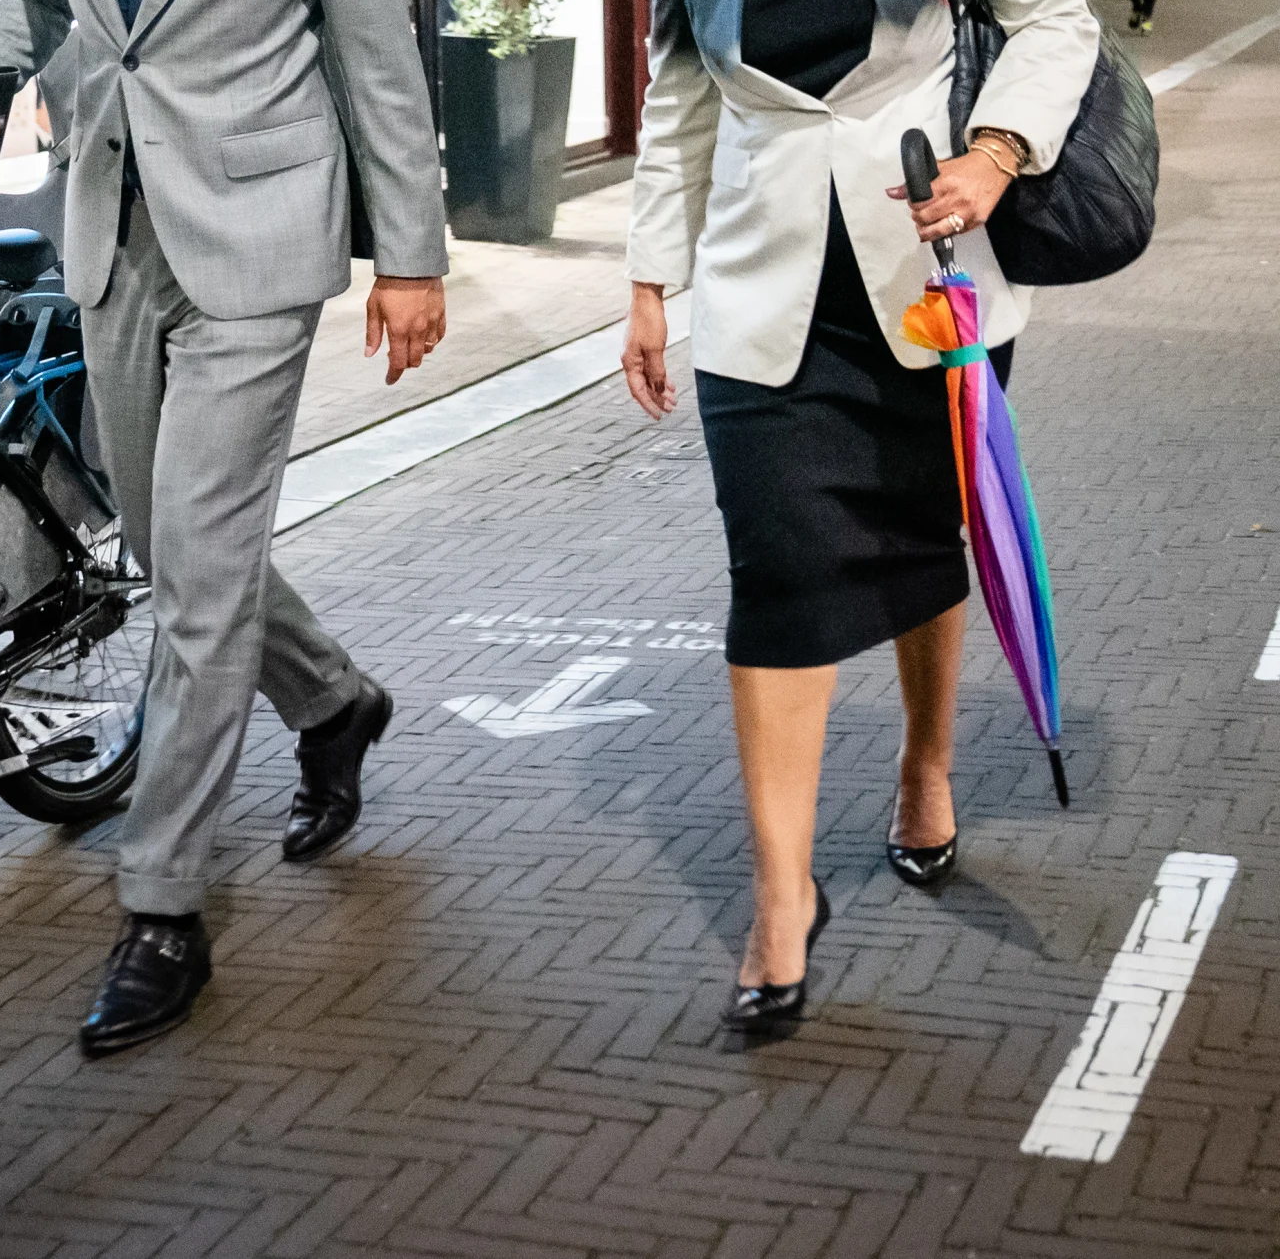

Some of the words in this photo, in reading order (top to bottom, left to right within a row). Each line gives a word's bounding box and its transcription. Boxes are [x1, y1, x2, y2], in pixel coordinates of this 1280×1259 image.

[447, 612, 567, 630] right
[576, 616, 657, 632] the
[664, 619, 719, 634] to
[475, 631, 634, 649] rechts
